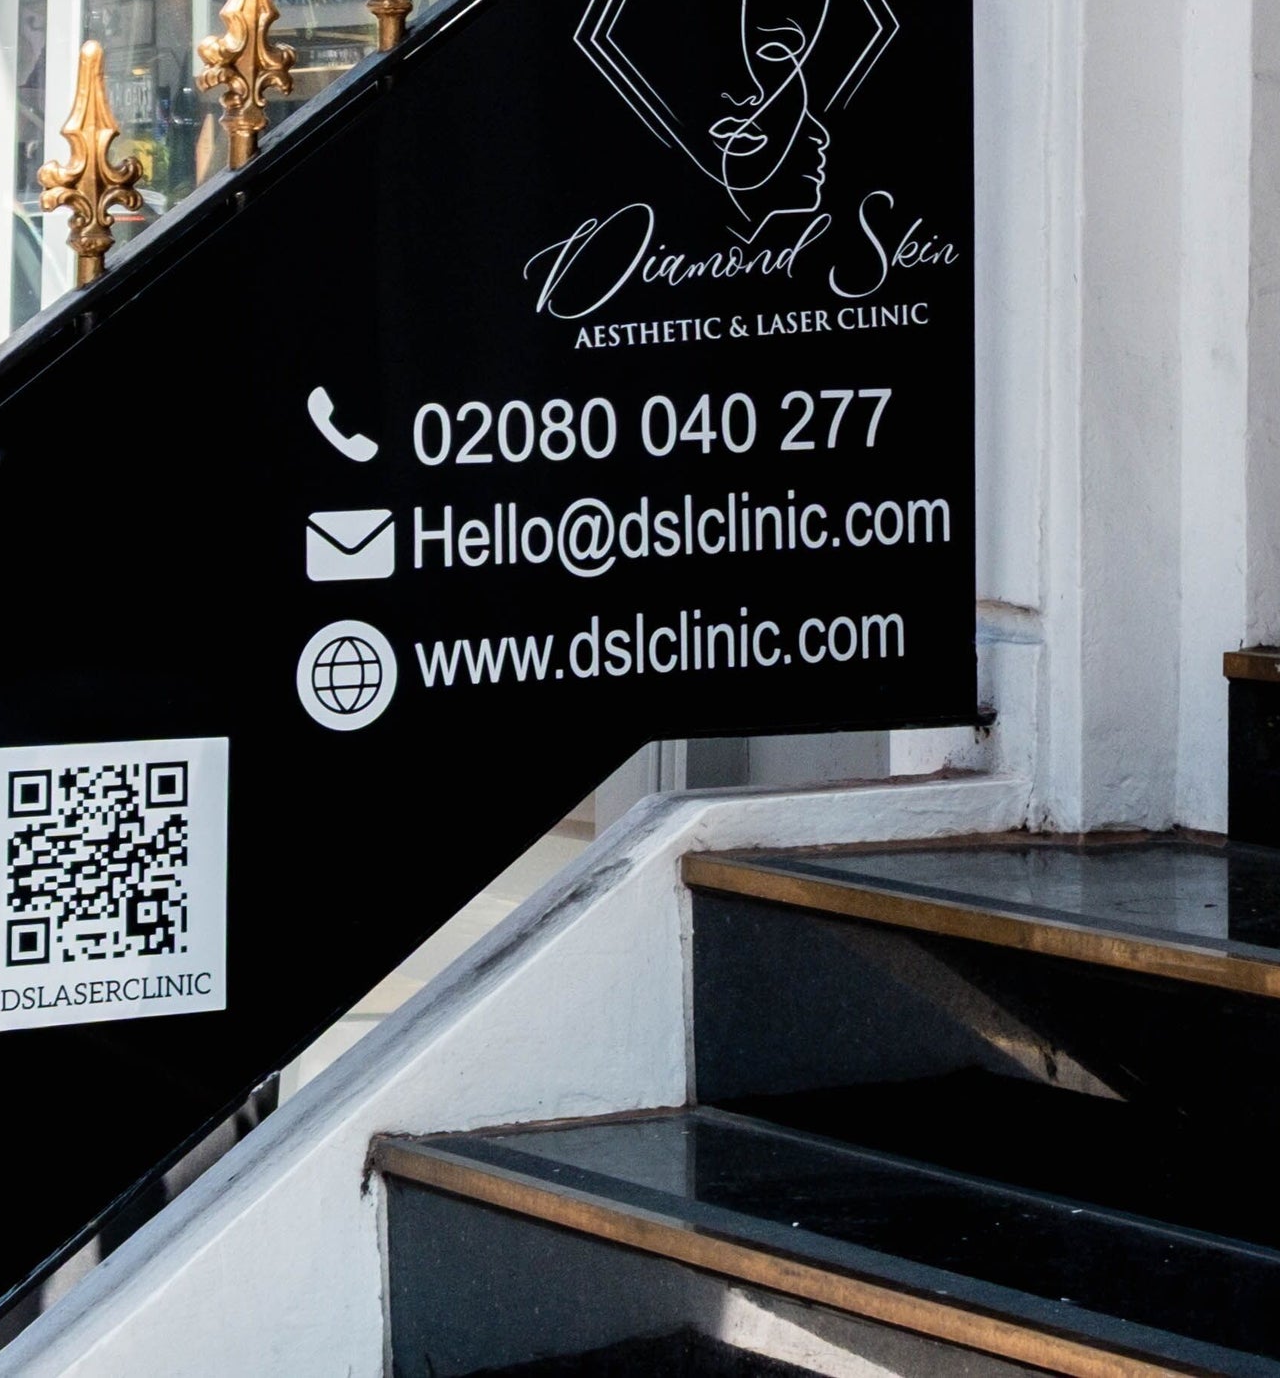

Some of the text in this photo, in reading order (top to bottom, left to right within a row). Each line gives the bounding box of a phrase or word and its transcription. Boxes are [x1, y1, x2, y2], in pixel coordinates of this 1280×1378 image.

[524, 190, 960, 319] Diamond Skin
[575, 302, 929, 349] AESTHETIC & LASER CLINIC
[414, 388, 892, 466] 02080 040 277
[414, 489, 950, 578] Hello@dslclinic.com
[414, 606, 905, 688] www.dslclinic.com
